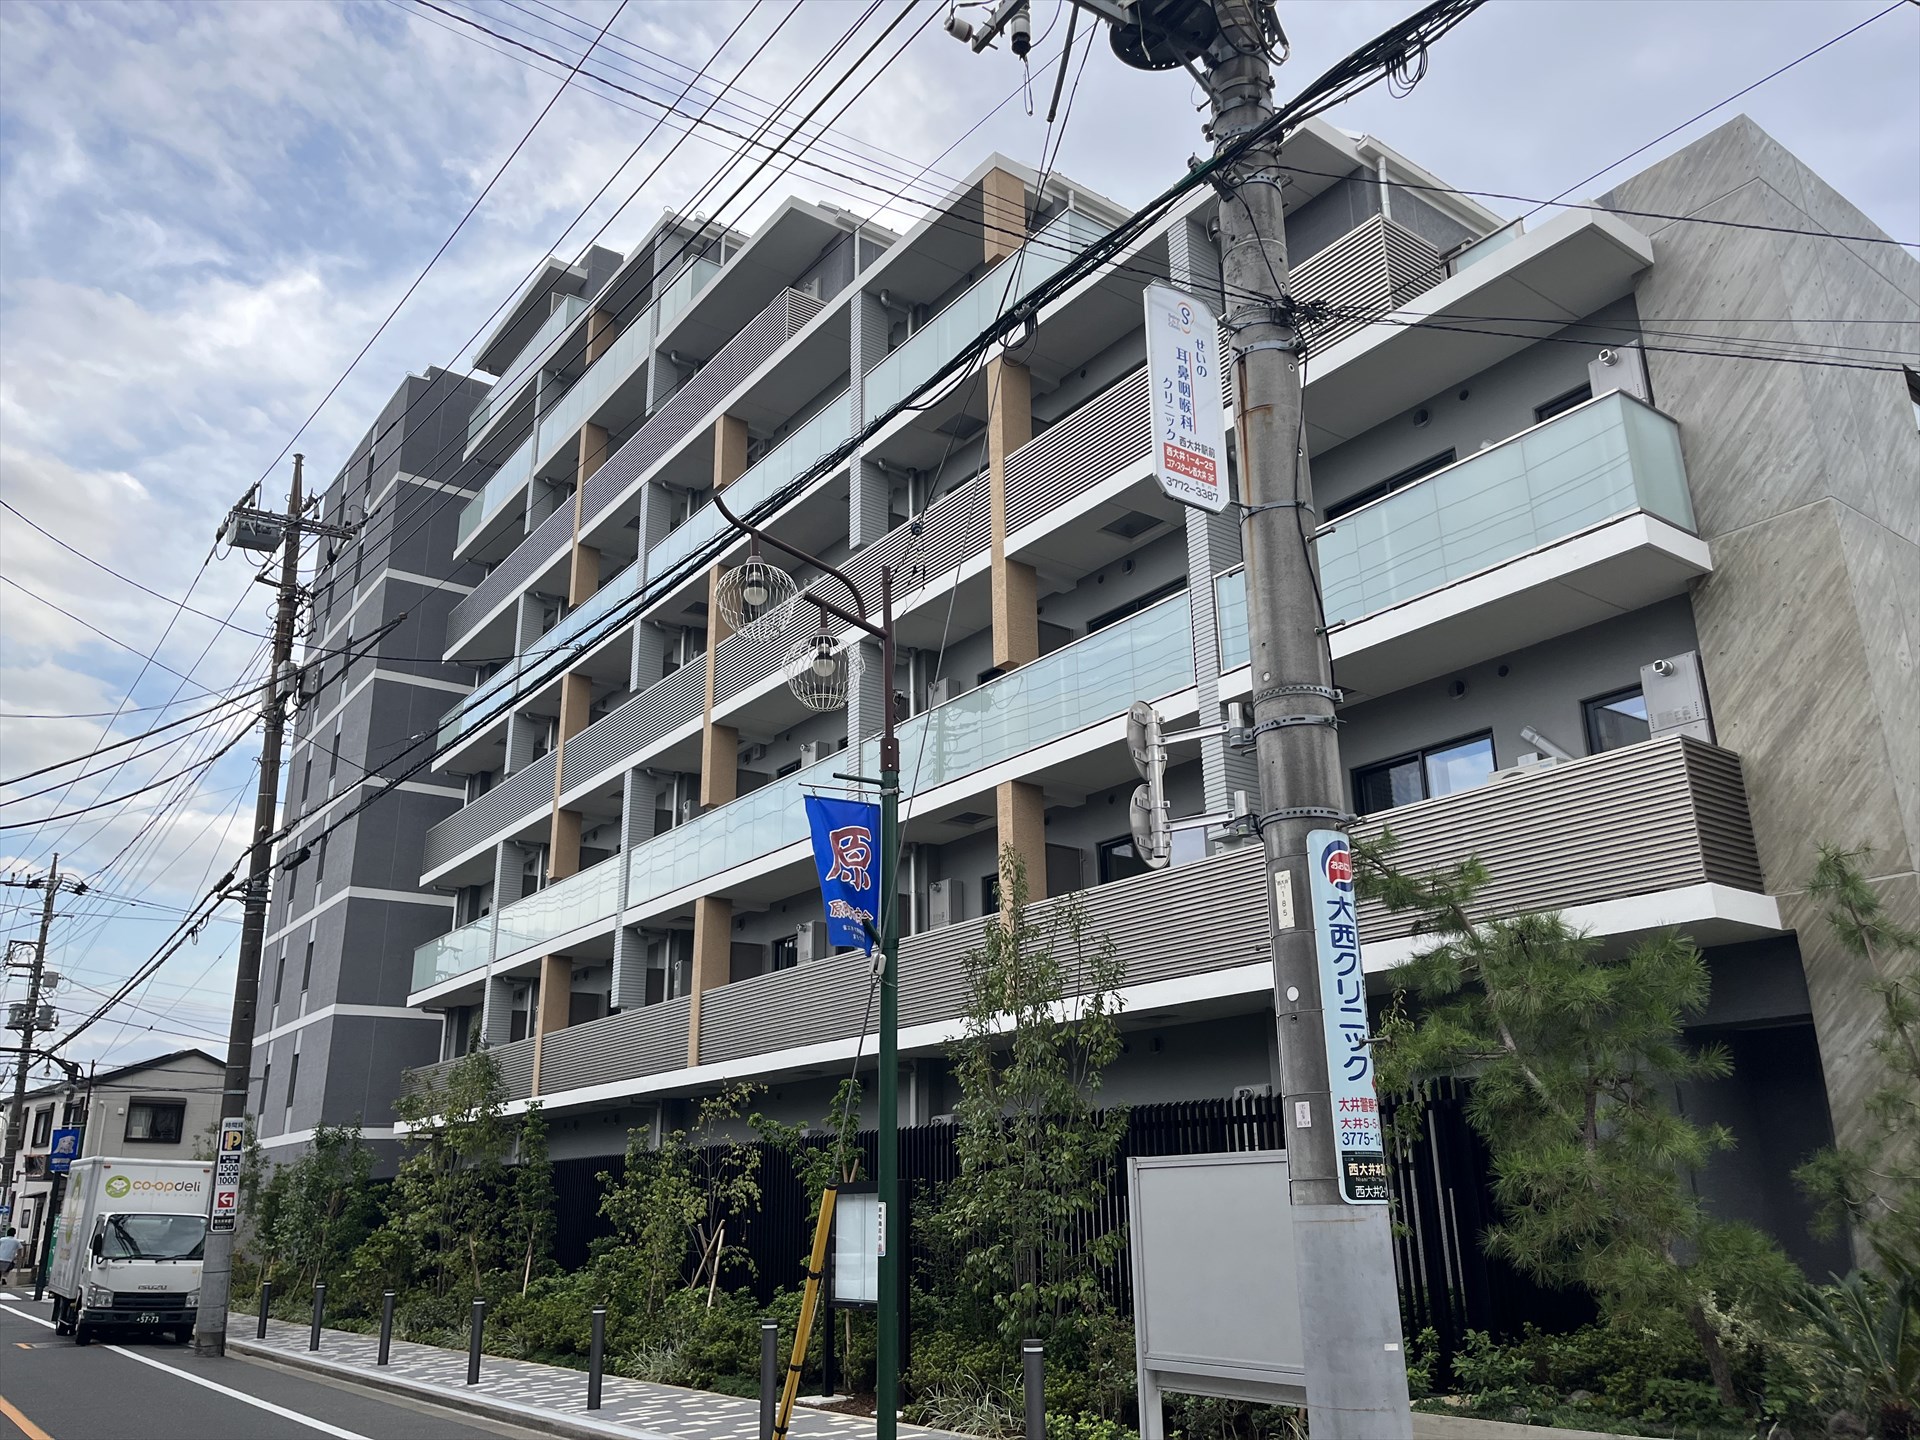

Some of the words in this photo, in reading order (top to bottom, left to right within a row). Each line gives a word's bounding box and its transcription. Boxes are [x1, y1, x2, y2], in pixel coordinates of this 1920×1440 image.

[1195, 338, 1208, 378] せいの
[1176, 346, 1193, 432] 耳鼻咽喉科
[1163, 377, 1176, 441] クリニック
[1166, 476, 1219, 503] 3772-3387
[826, 826, 872, 891] 原
[1326, 896, 1368, 1082] 大西クリニック
[1338, 1096, 1378, 1113] 大井警察
[1340, 1117, 1380, 1130] 大井5-5-
[218, 1176, 238, 1185] 1000
[220, 1164, 239, 1172] 1500
[133, 1181, 200, 1192] co-opdeli
